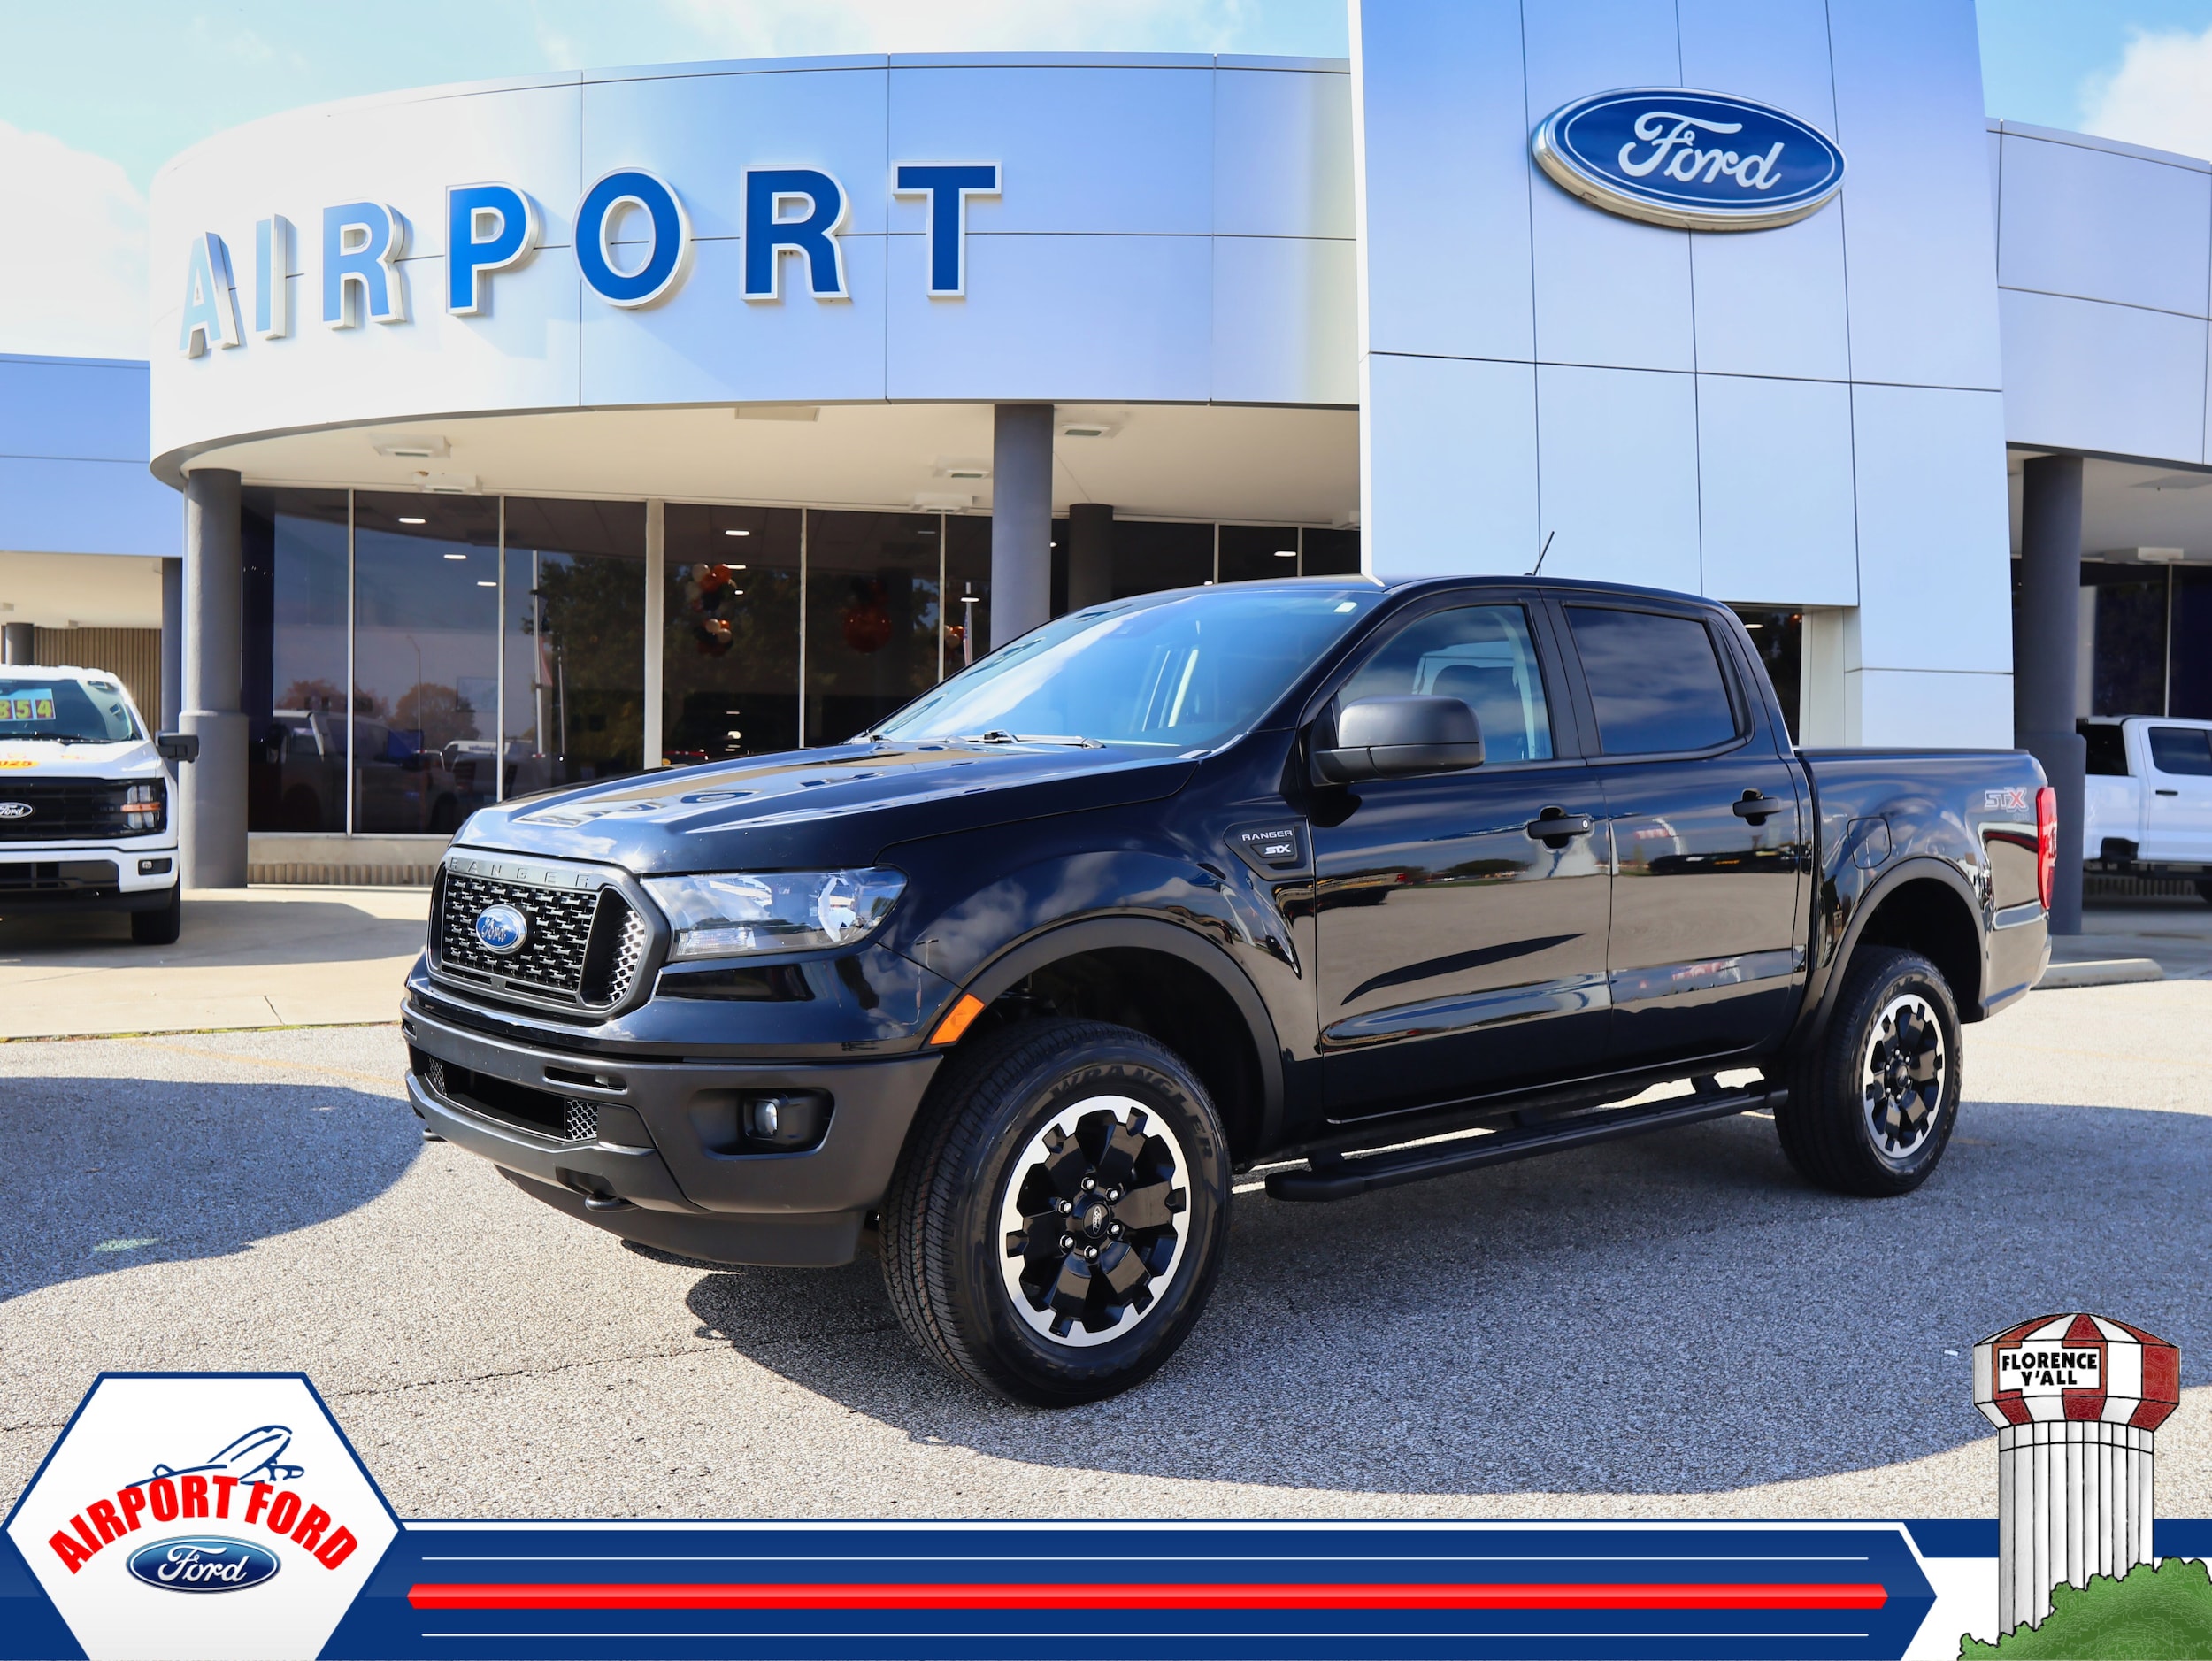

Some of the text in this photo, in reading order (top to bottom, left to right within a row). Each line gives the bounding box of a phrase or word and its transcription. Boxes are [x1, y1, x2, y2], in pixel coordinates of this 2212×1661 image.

[1618, 112, 1785, 189] Ford
[179, 160, 1002, 359] AIRPORT
[1984, 787, 2030, 812] STX
[1241, 830, 1293, 841] RANGER
[1264, 844, 1291, 855] STX
[449, 857, 590, 888] RANGER
